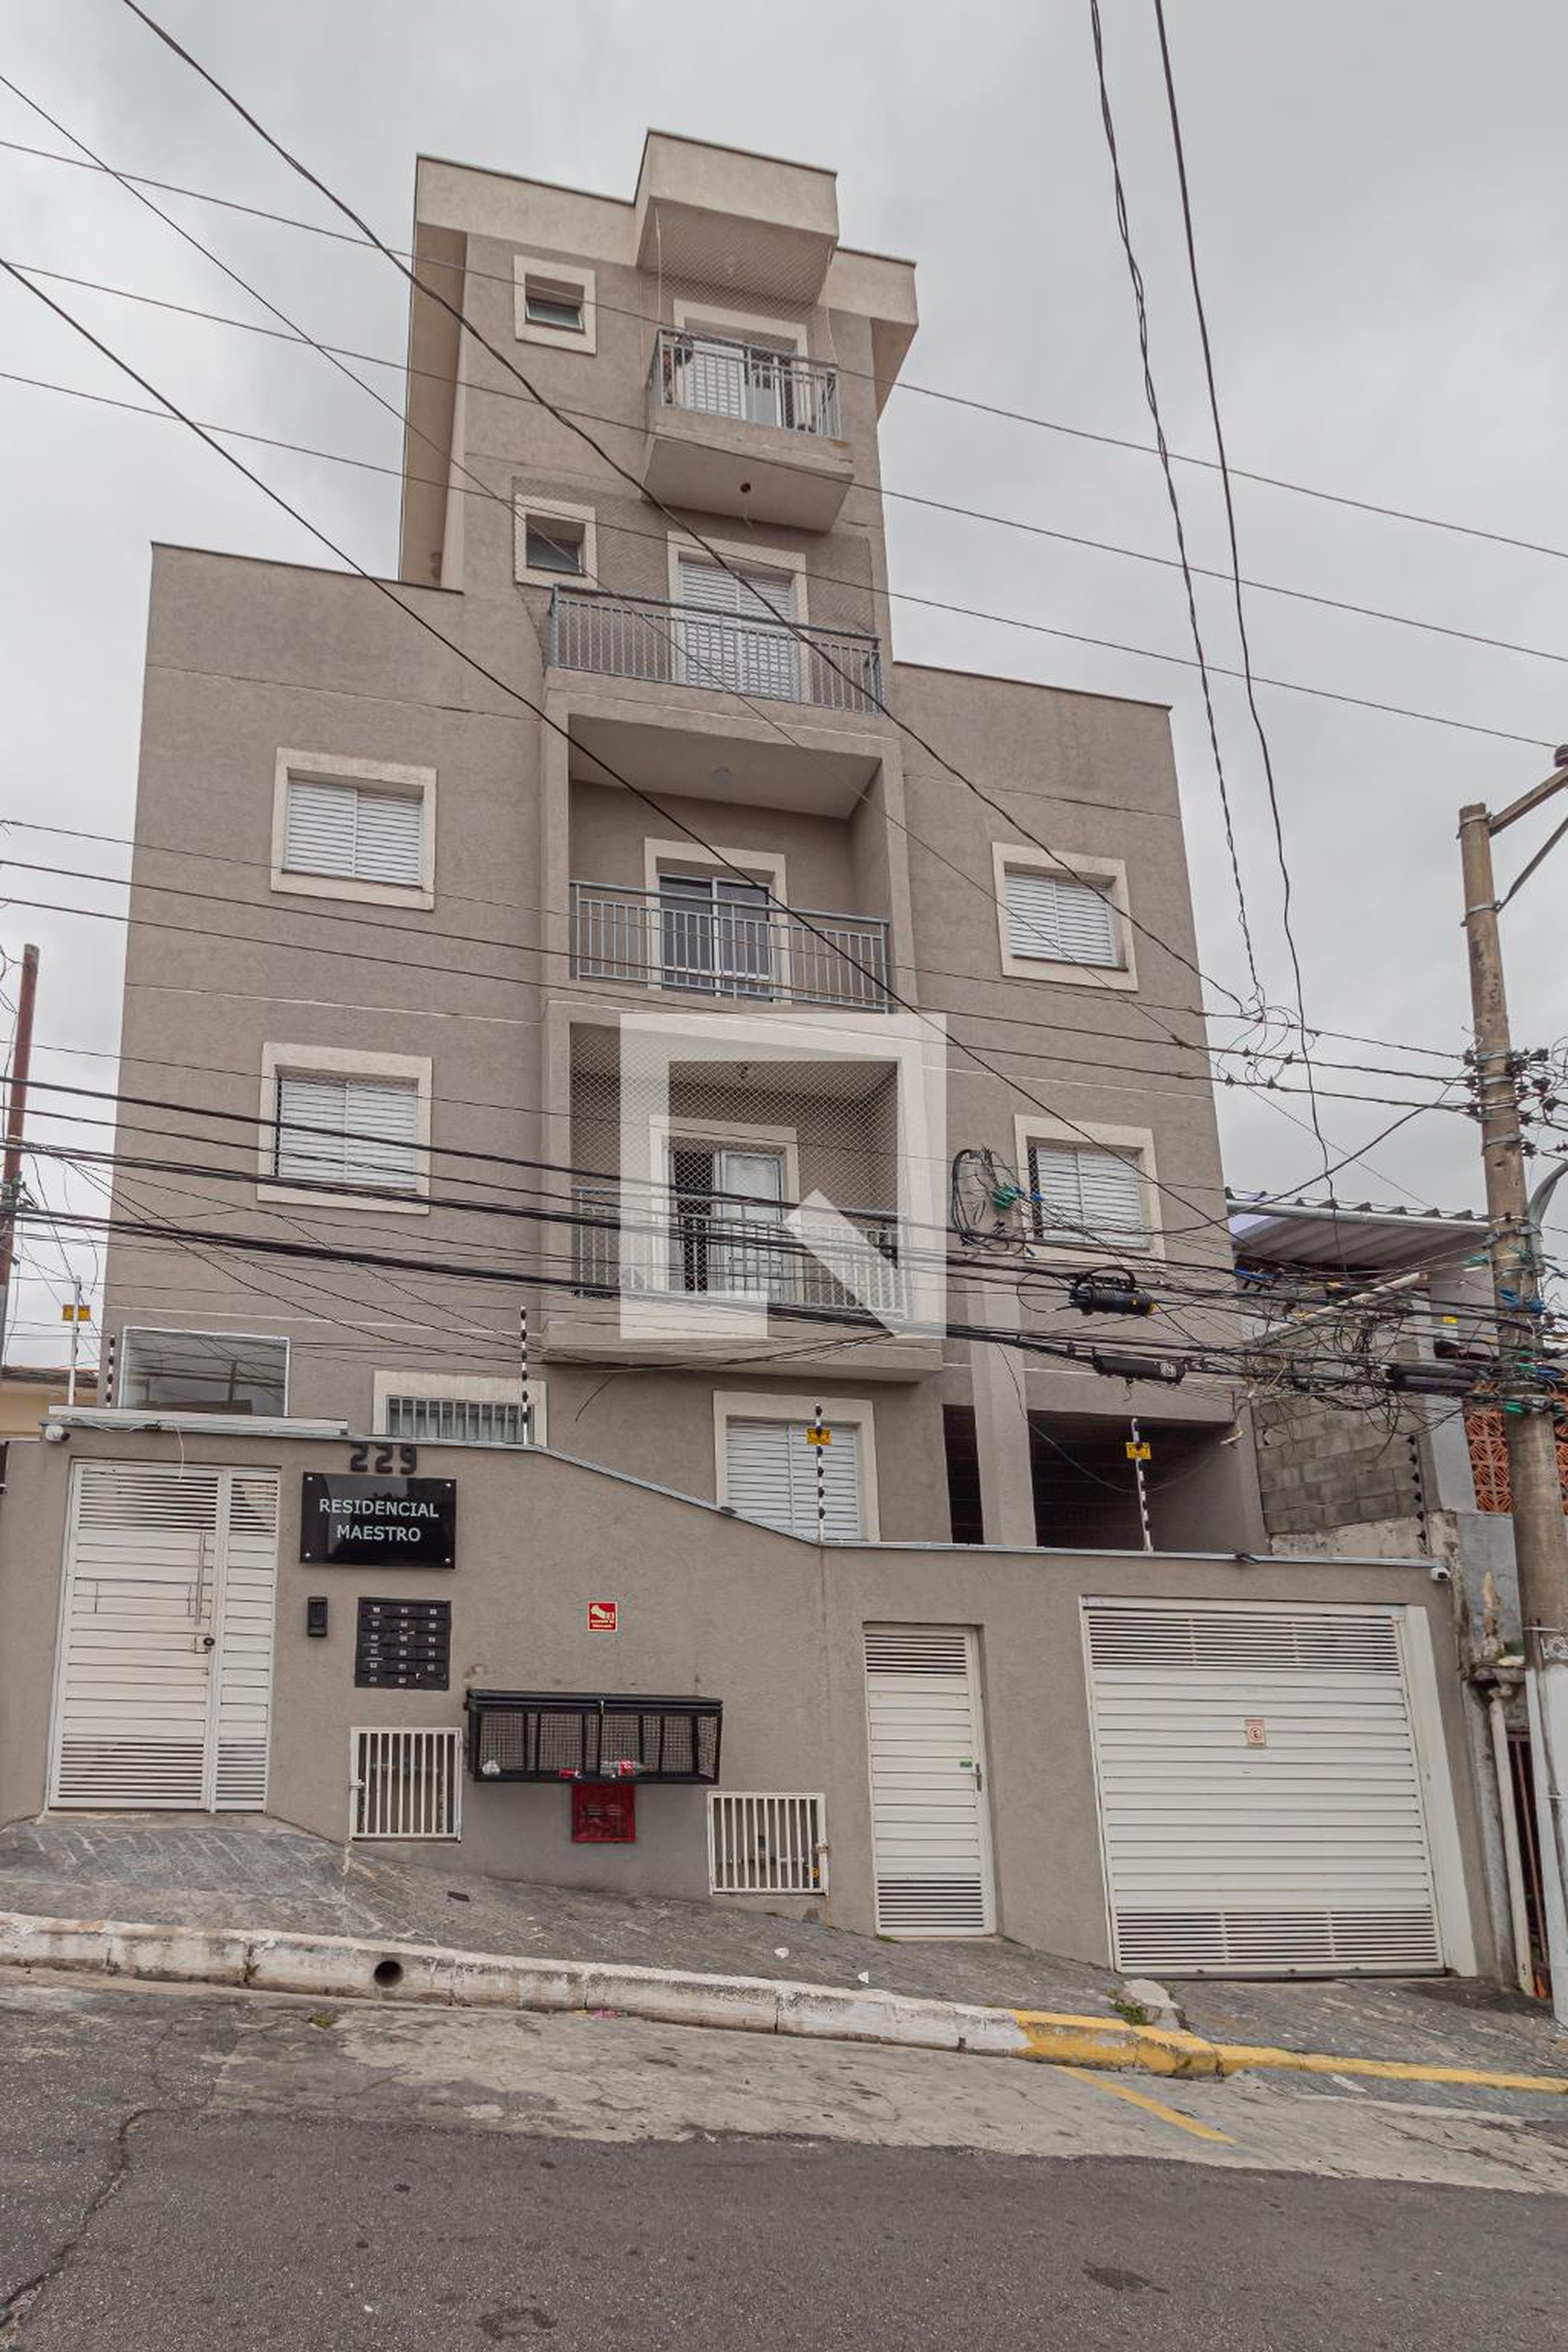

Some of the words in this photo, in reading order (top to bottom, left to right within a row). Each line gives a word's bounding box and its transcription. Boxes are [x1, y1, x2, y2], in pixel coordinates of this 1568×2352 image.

[350, 1443, 416, 1474] 229
[319, 1498, 439, 1517] RESIDENCIAL
[336, 1524, 421, 1542] MAESTRO
